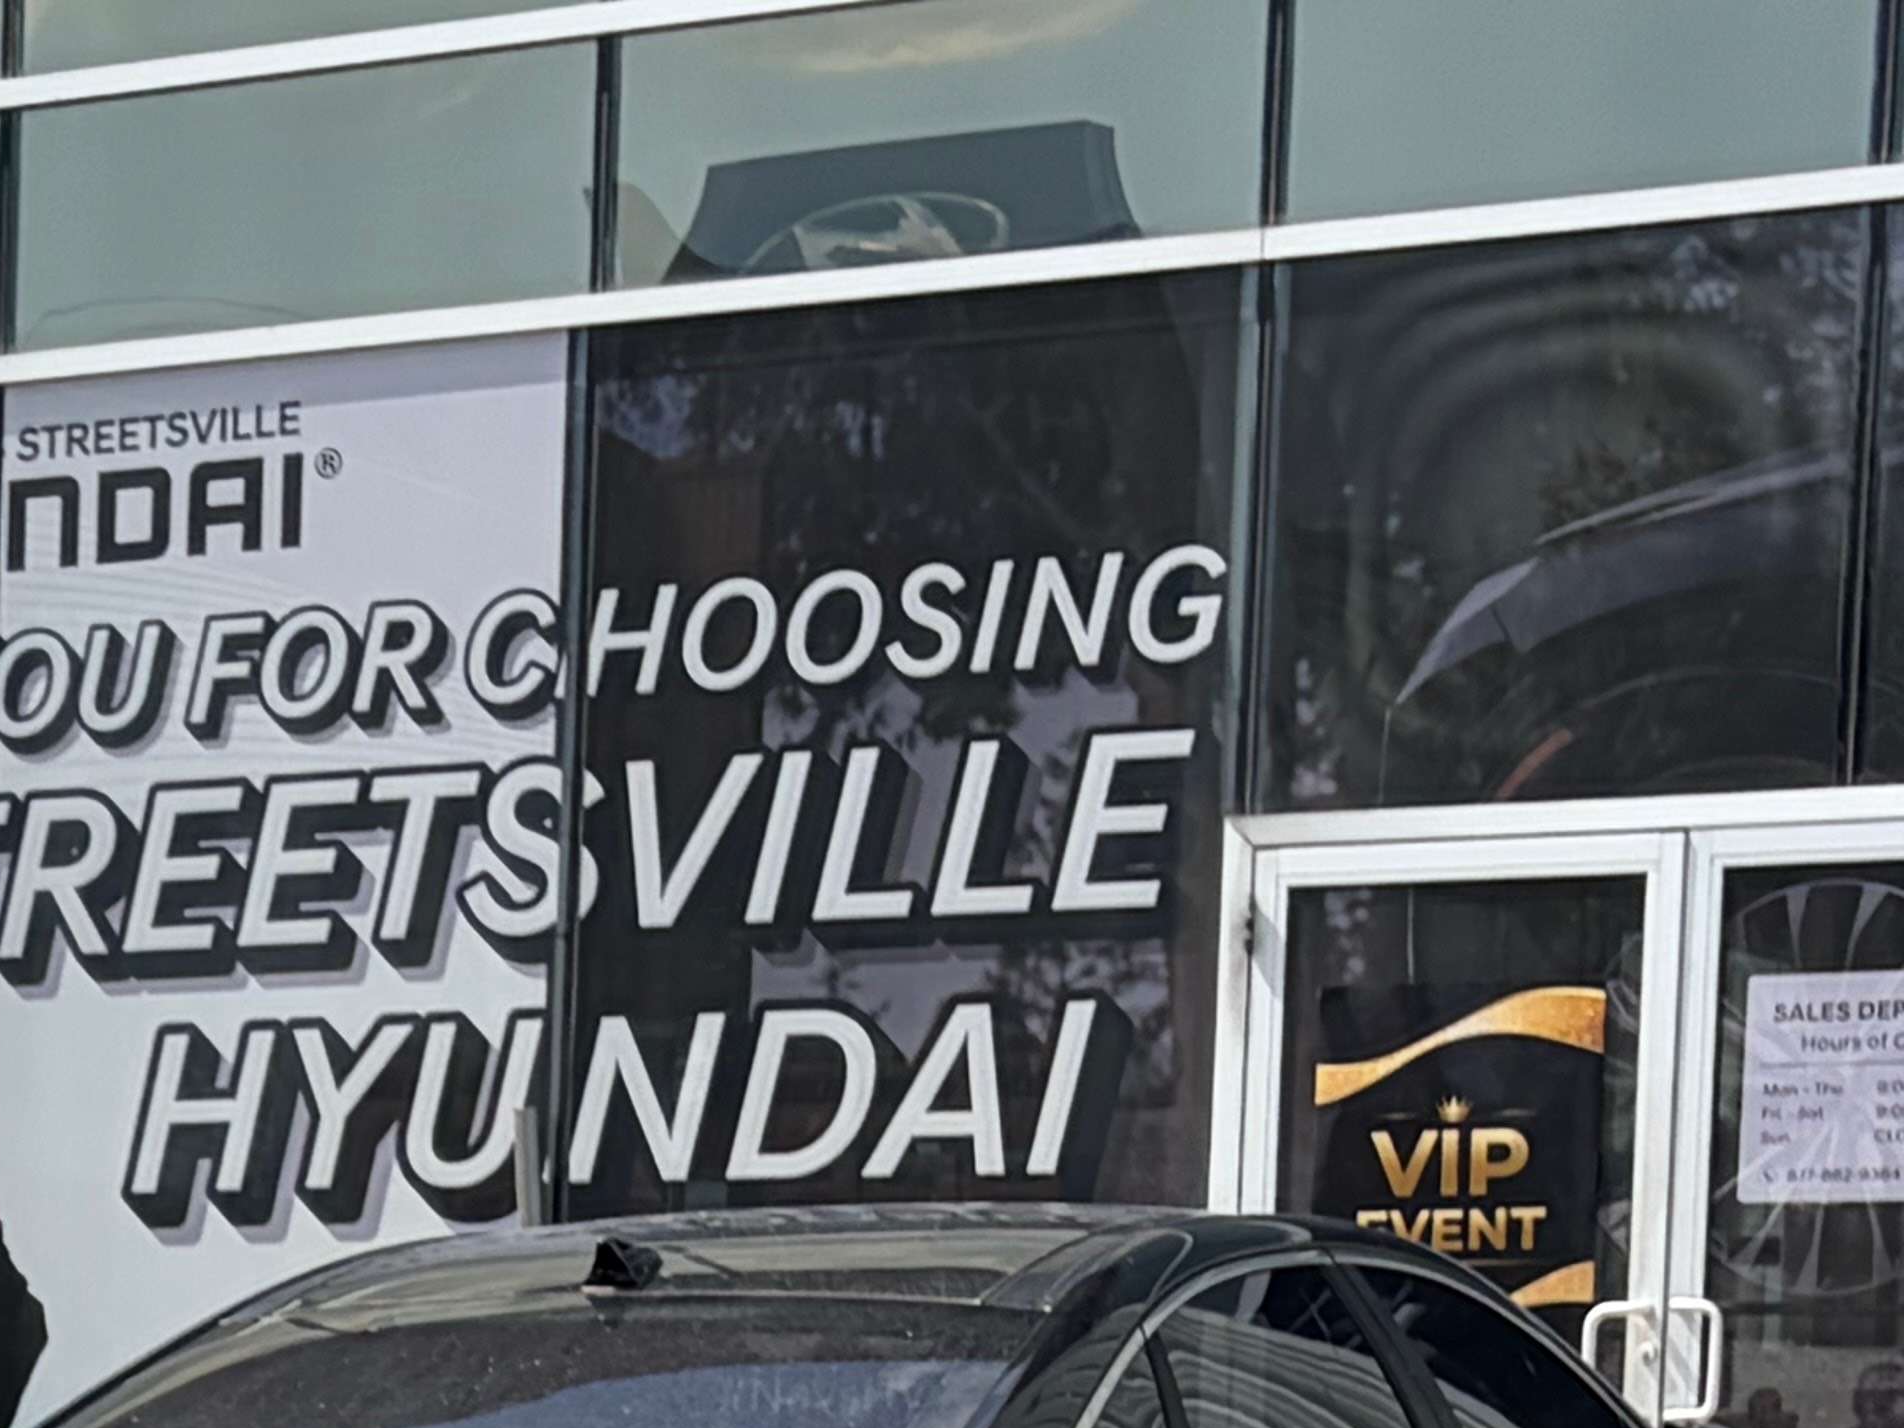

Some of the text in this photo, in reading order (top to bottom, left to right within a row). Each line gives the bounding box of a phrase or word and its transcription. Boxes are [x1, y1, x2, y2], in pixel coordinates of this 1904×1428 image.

[16, 401, 303, 461] STREETSVILLE
[184, 599, 450, 746] FOR
[463, 544, 1228, 720] CHOOSING
[1773, 1001, 1851, 1023] SALES
[1801, 1033, 1862, 1052] Hours
[1867, 1031, 1888, 1050] of
[122, 998, 1122, 1235] HYUNDAI
[1370, 1126, 1530, 1198] VIP
